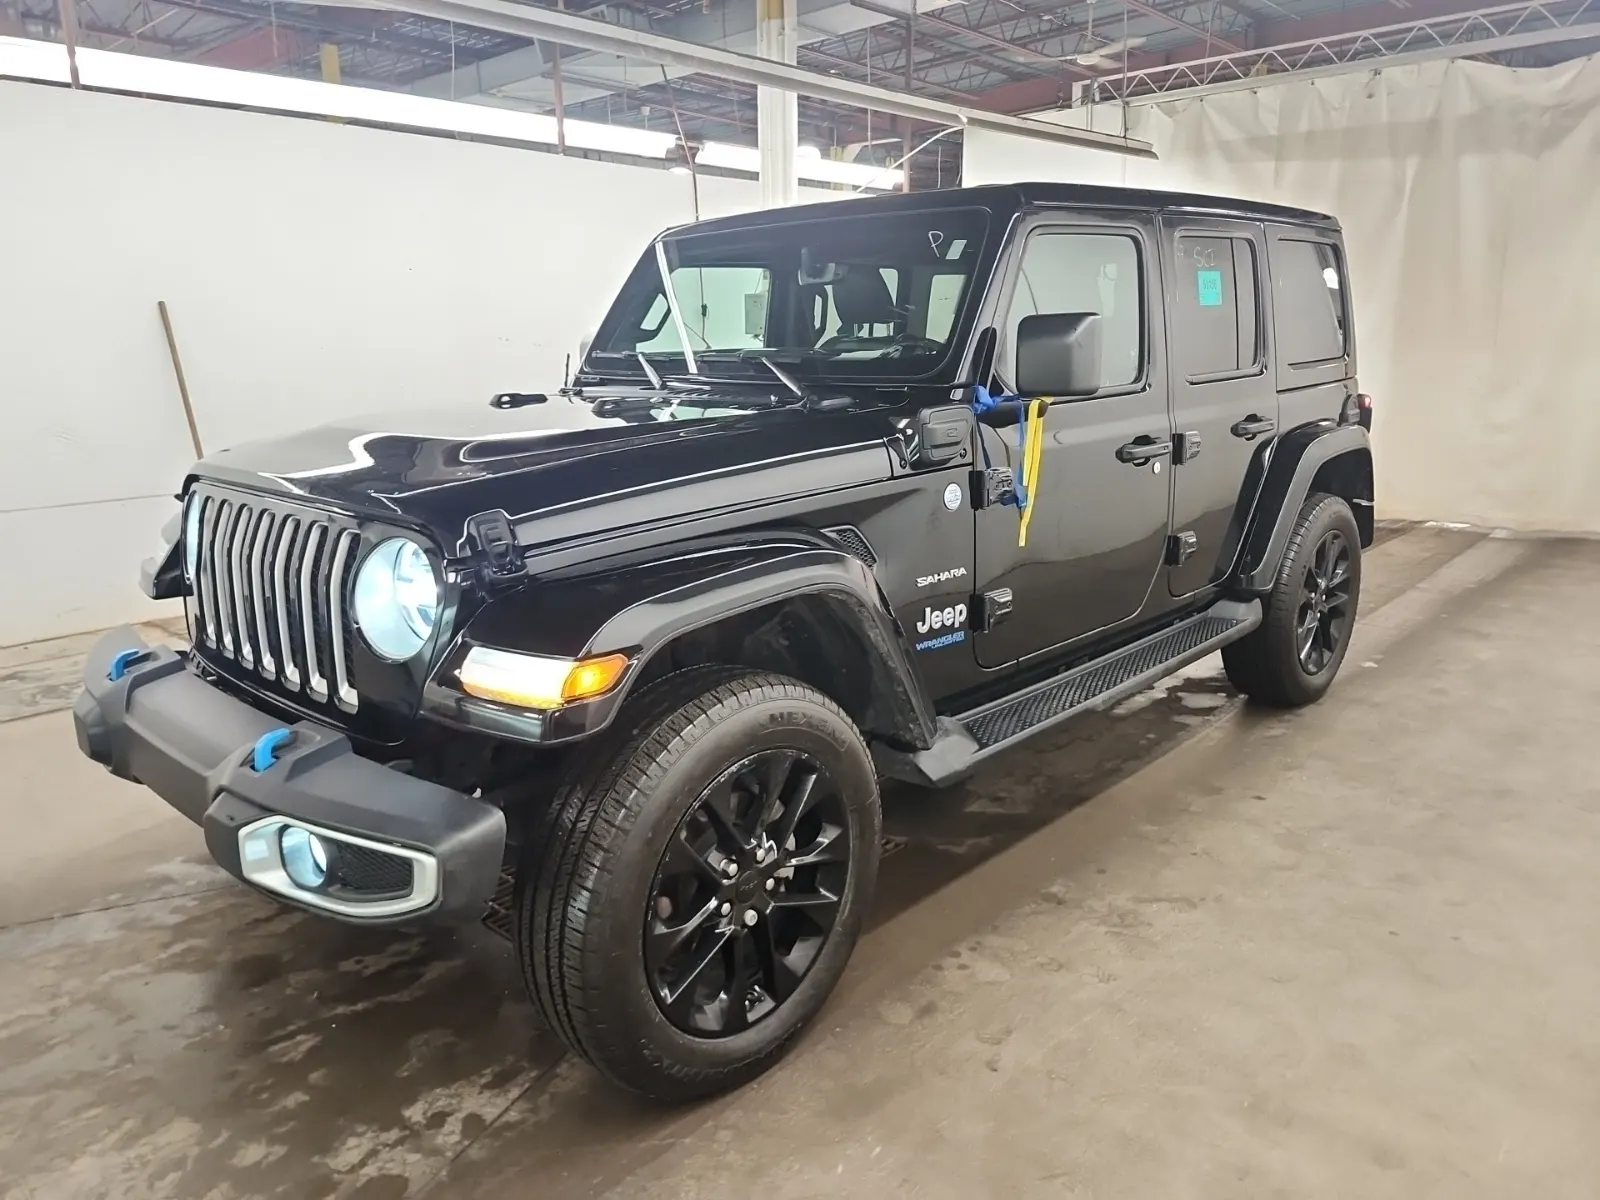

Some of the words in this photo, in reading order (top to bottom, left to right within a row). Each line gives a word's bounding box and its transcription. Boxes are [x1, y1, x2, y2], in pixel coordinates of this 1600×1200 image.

[928, 230, 944, 257] P
[916, 567, 967, 587] SAHARA
[916, 603, 967, 633] Jeep
[916, 631, 964, 650] WRANGLER
